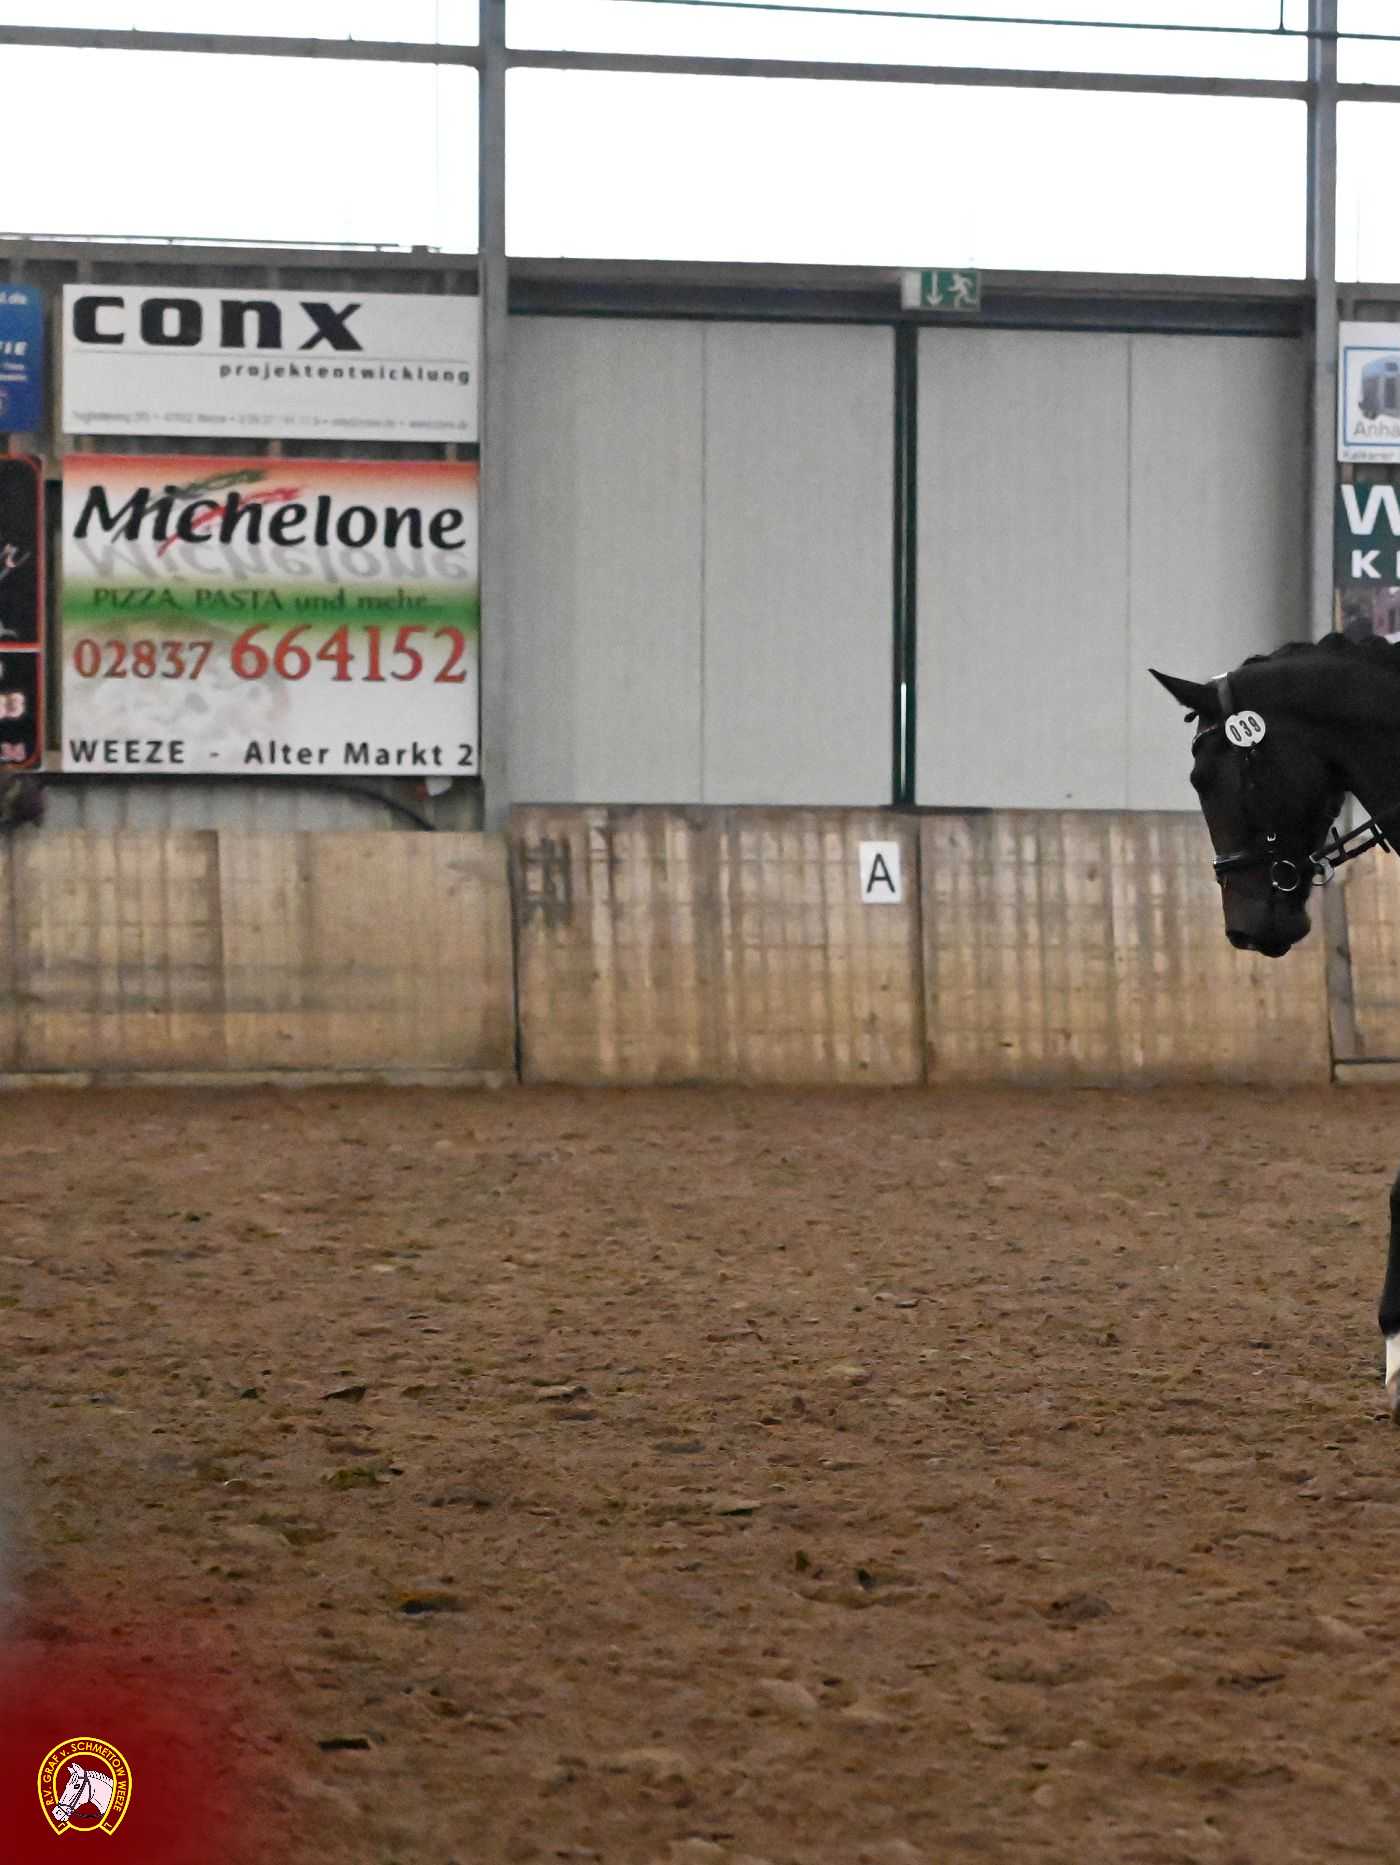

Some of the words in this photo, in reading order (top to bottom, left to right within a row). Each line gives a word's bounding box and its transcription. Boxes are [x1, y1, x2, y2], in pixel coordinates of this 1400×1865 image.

[73, 296, 363, 350] conx
[219, 364, 471, 385] projektentwicklung
[74, 485, 465, 550] Michelone
[195, 589, 283, 611] PASTA
[73, 638, 213, 679] 02837
[231, 624, 468, 684] 664152
[70, 740, 185, 764] WEEZE
[244, 742, 328, 766] Alter
[344, 742, 443, 767] Markt
[458, 744, 473, 766] 2
[866, 853, 896, 893] A
